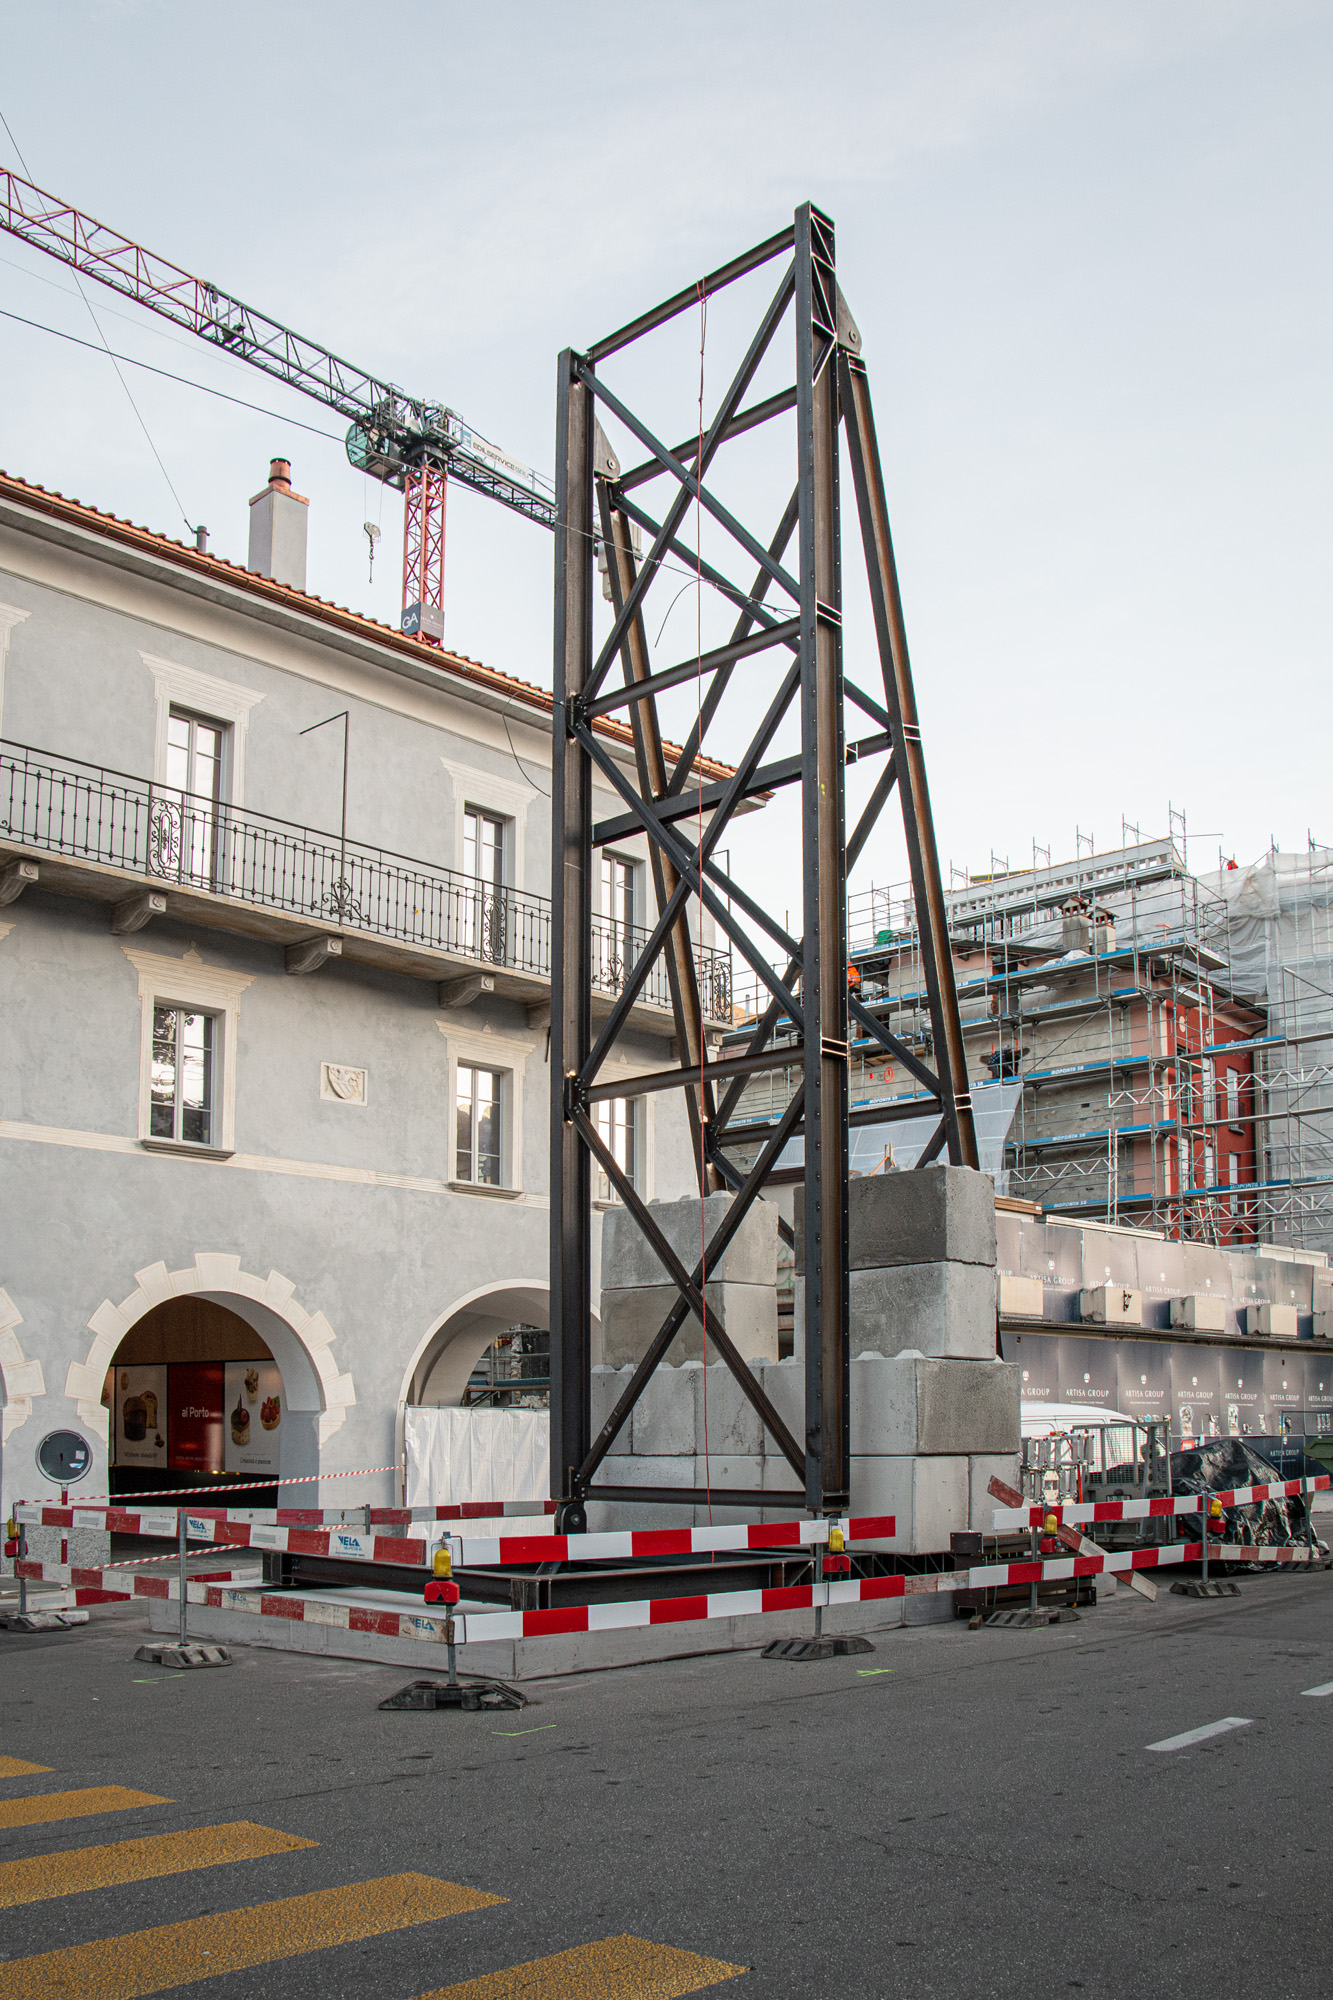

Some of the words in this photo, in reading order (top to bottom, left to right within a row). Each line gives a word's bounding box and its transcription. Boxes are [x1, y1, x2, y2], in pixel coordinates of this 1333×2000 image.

[1053, 1276, 1075, 1286] GROUP
[1145, 1286, 1163, 1294] ARTISA
[1163, 1287, 1181, 1296] GROUP
[1027, 1387, 1050, 1396] GROUP
[1065, 1388, 1086, 1397] ARTISA
[1087, 1389, 1110, 1398] GROUP
[1125, 1390, 1144, 1398] ARTISA
[1144, 1390, 1165, 1398] GROUP
[1177, 1391, 1195, 1399] ARTISA
[1195, 1391, 1214, 1399] GROUP
[1224, 1392, 1240, 1400] ARTISA
[1285, 1394, 1300, 1402] GROUP
[182, 1407, 189, 1418] al
[190, 1406, 210, 1418] Porto
[188, 1519, 206, 1530] VELA
[337, 1535, 361, 1547] VELA
[409, 1616, 435, 1631] VELA
